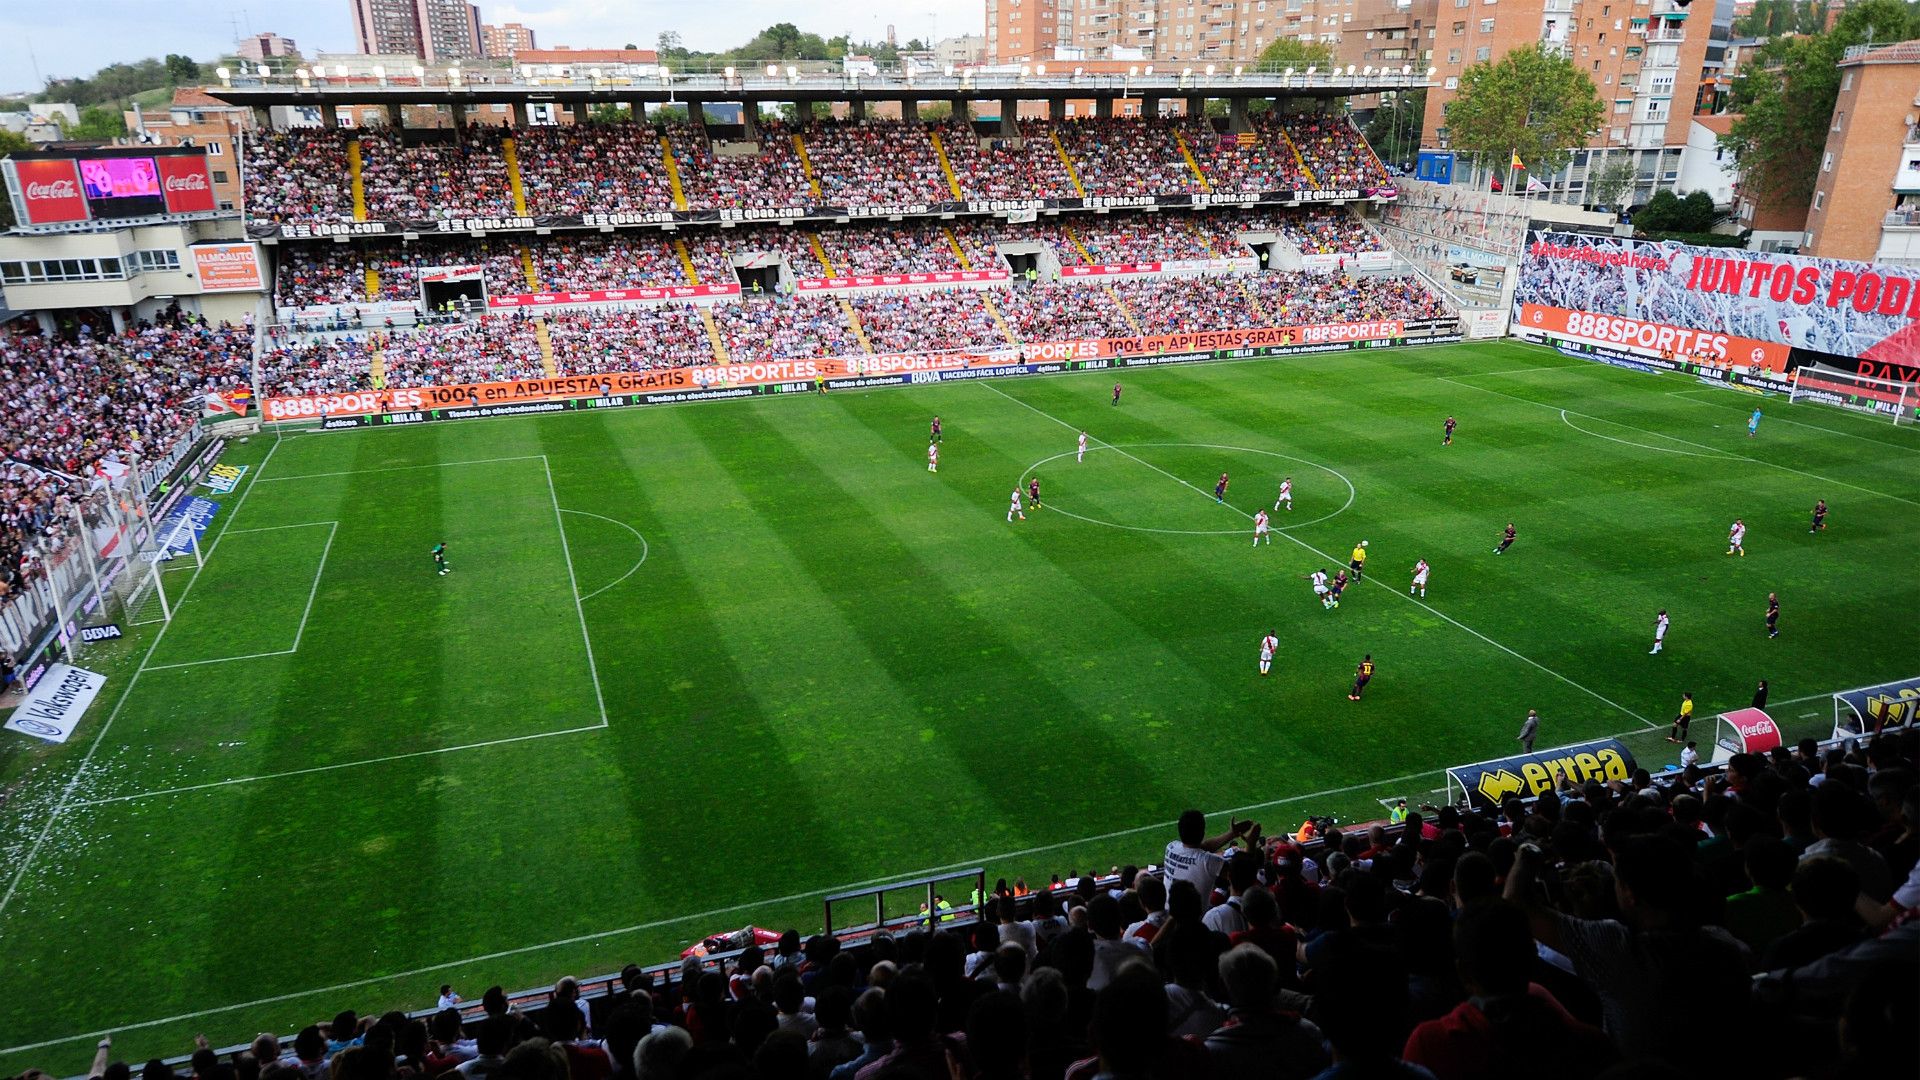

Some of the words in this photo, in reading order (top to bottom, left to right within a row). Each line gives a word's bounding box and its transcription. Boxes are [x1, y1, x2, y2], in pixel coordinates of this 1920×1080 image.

[1531, 241, 1668, 271] #AhoraRayoAhora
[1686, 255, 1822, 306] JUNTOS
[1303, 322, 1398, 341] 888SPORT.ES
[1566, 310, 1728, 360] 888SPORT.ES
[1108, 338, 1142, 353] 100€
[1148, 338, 1164, 351] en
[1170, 332, 1242, 350] APUESTAS
[692, 361, 817, 384] 888SPORT.ES
[912, 372, 941, 383] BBVA
[942, 370, 976, 380] HACEMOS
[976, 368, 995, 378] FÁCIL
[1006, 364, 1028, 375] DIFÍCIL
[430, 386, 479, 404] 100€
[485, 387, 507, 400] en
[514, 378, 612, 397] APUESTAS
[618, 371, 684, 389] GRATIS
[829, 380, 854, 389] Tiendas
[856, 379, 865, 387] de
[1742, 376, 1767, 388] Tiendas
[1768, 381, 1777, 390] de
[647, 394, 675, 402] Tiendas
[676, 392, 686, 400] de
[448, 408, 478, 418] Tiendas
[480, 406, 490, 415] de
[492, 402, 563, 414] electrodomésticos
[81, 626, 121, 641] BBVA
[26, 668, 92, 721] Volkswagen
[1742, 720, 1772, 738] Coca-Cola
